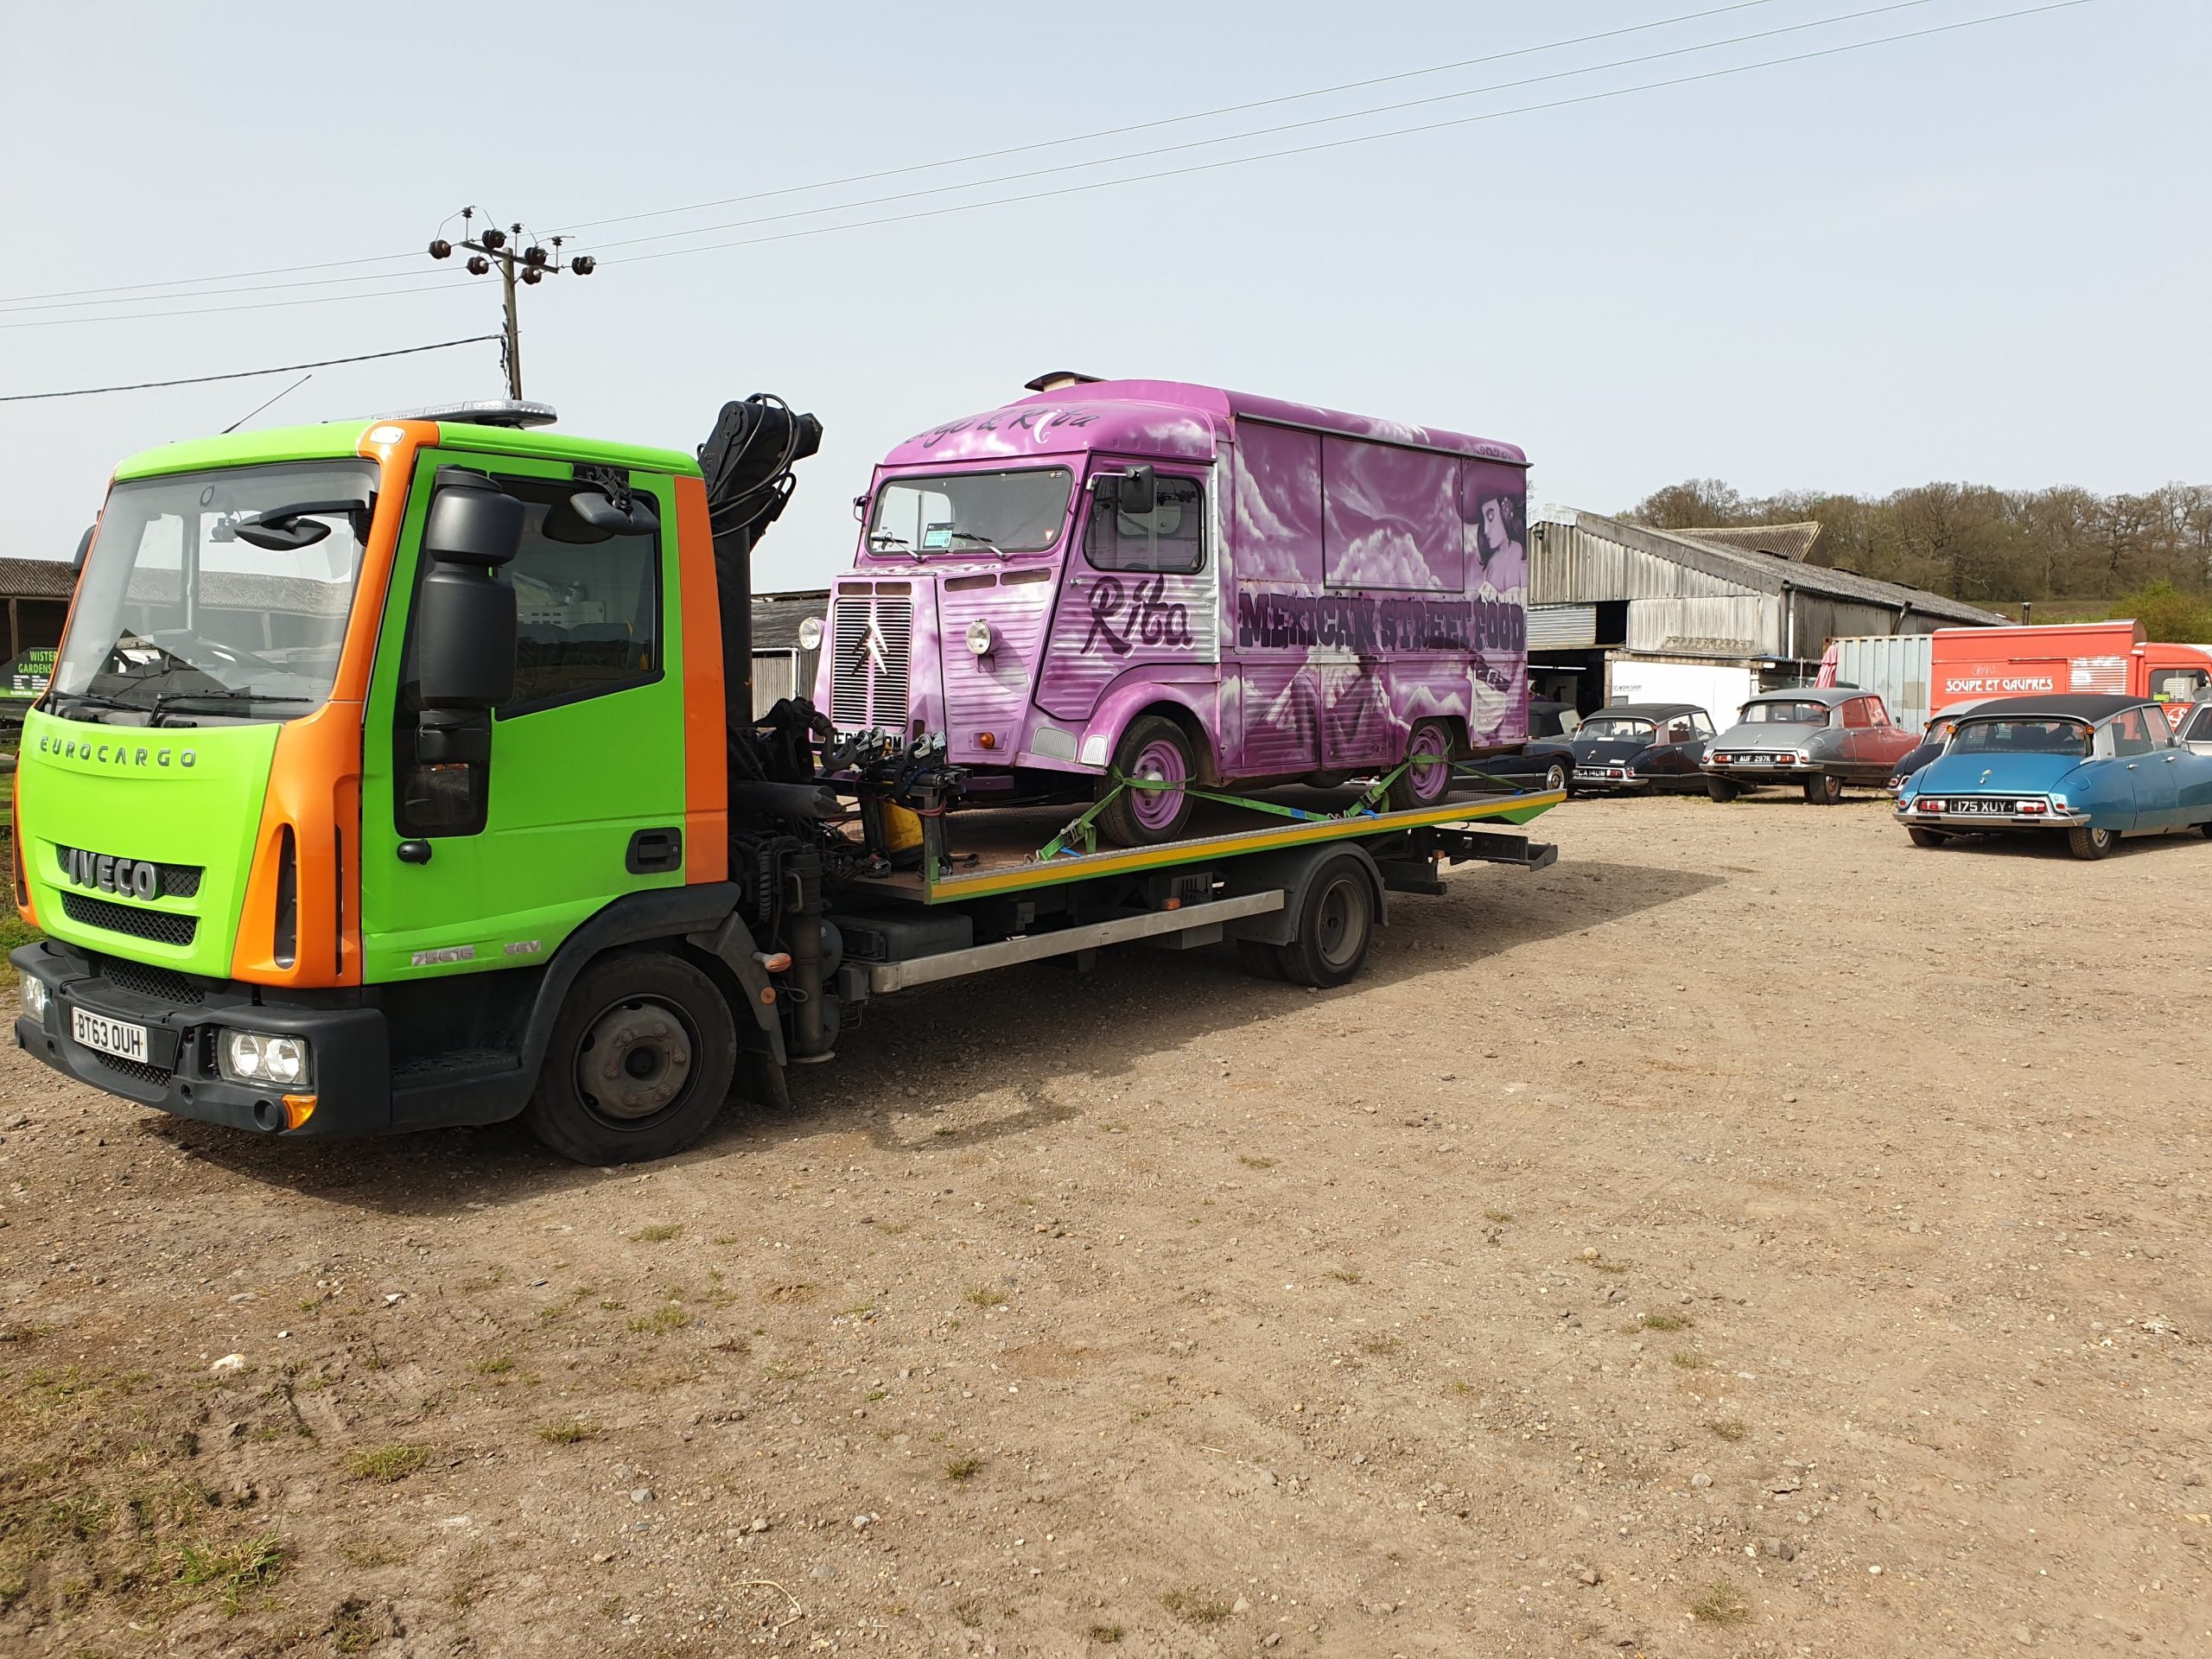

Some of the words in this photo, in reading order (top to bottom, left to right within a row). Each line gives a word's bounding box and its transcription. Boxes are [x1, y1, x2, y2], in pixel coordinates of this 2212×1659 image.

[1080, 574, 1194, 658] Rita
[1239, 593, 1376, 652] MEXICAN
[1381, 600, 1471, 651] STREET
[1473, 599, 1524, 651] FOOD
[18, 664, 52, 674] GARDENS
[1986, 679, 1999, 691] ET
[40, 735, 196, 767] EUROCARGO
[1958, 801, 1978, 812] 175
[1981, 801, 2006, 812] XUY
[69, 849, 157, 901] IVECO
[78, 1014, 108, 1047] BT63
[111, 1025, 141, 1056] OUH
